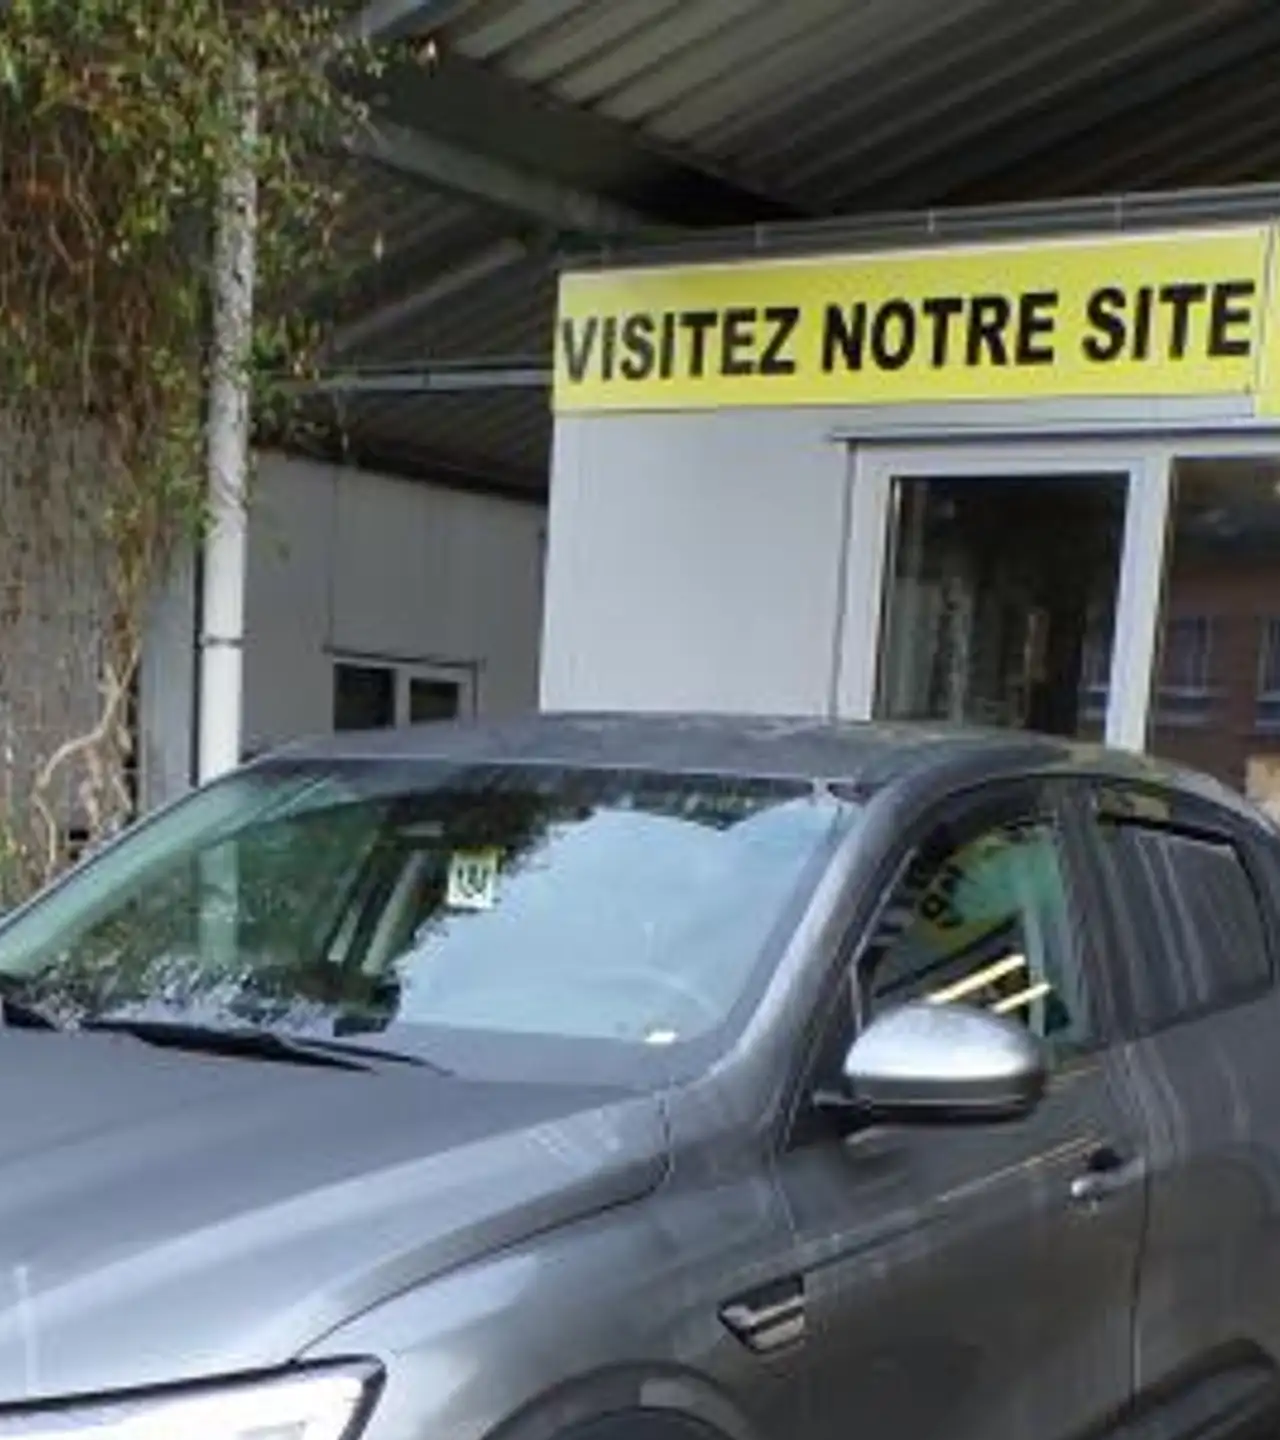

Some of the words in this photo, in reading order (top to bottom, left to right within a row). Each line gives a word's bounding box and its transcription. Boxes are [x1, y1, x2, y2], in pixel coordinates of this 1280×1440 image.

[561, 306, 800, 383] VISITEZ
[821, 292, 1060, 373] NOTRE
[1081, 280, 1256, 363] SITE
